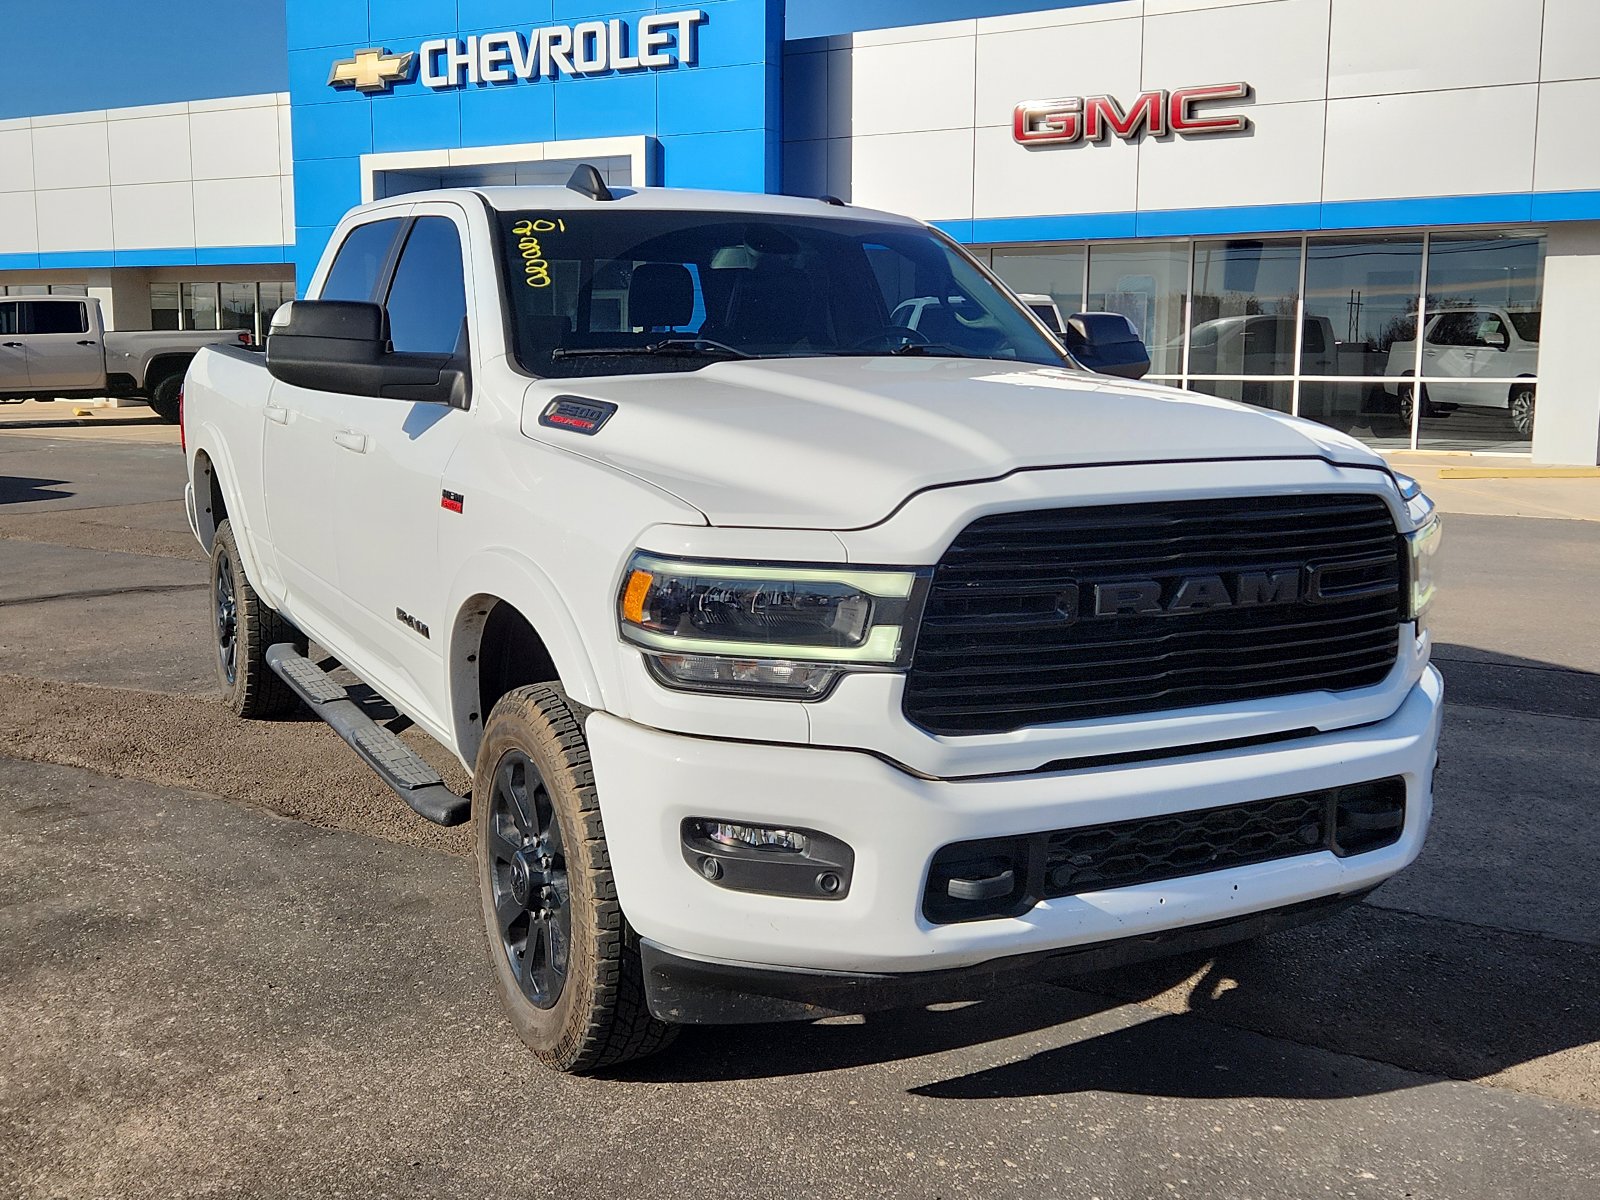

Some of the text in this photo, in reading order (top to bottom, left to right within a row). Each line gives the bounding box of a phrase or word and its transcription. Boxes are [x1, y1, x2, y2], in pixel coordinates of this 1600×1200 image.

[419, 9, 705, 88] CHEVROLET
[1012, 81, 1251, 147] GMC
[512, 218, 565, 236] 201
[1094, 569, 1300, 616] RAM
